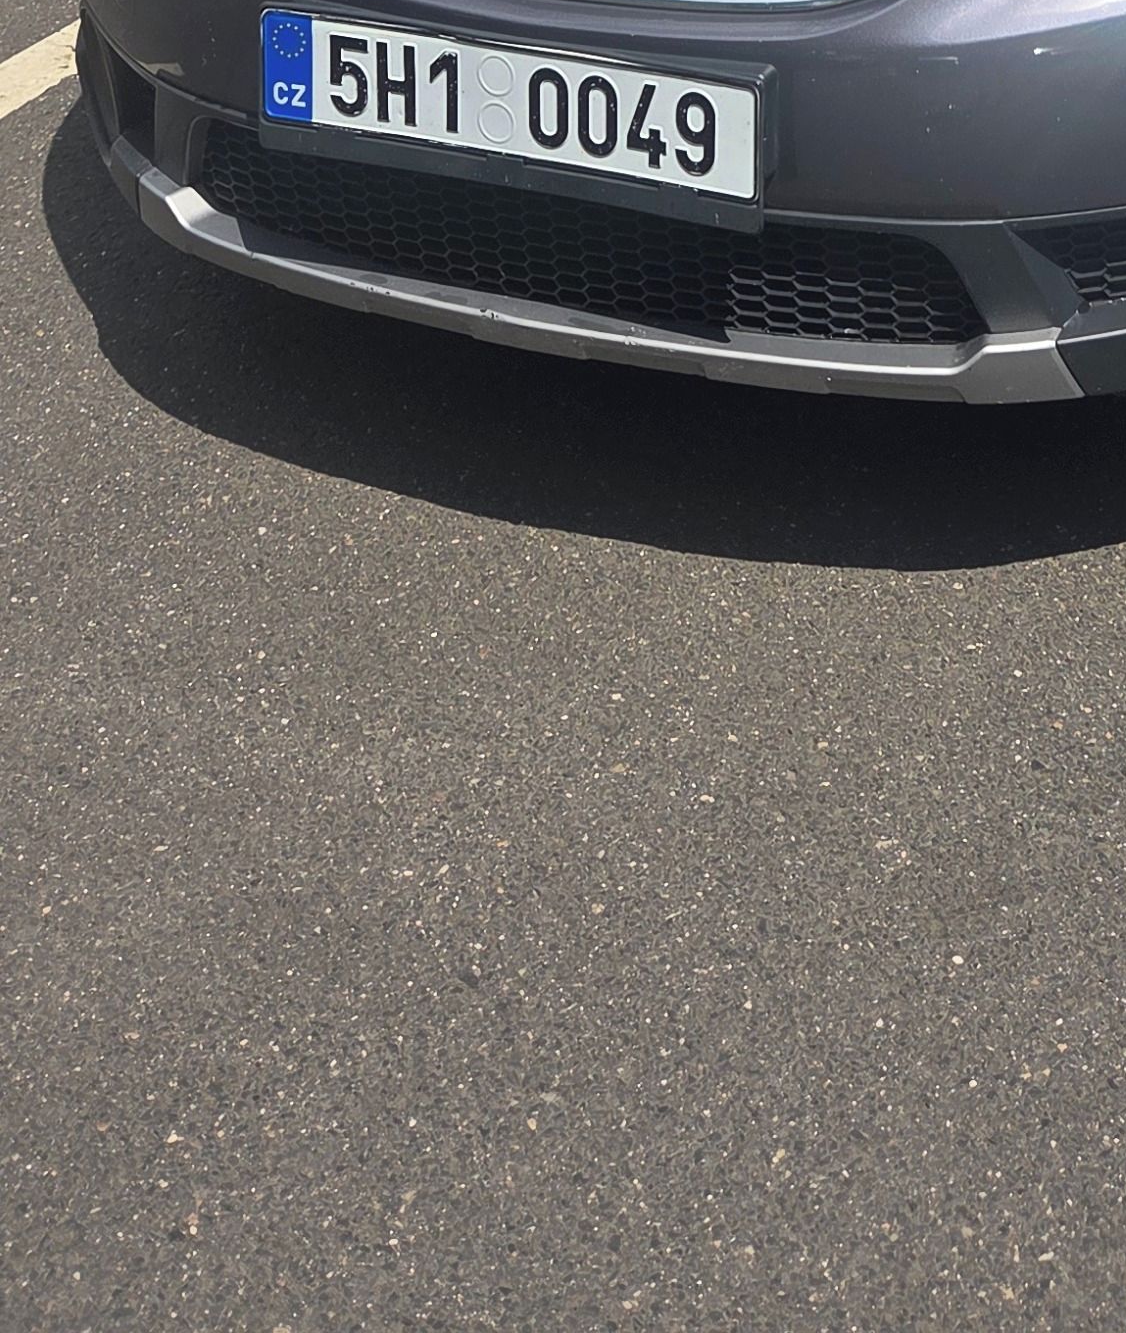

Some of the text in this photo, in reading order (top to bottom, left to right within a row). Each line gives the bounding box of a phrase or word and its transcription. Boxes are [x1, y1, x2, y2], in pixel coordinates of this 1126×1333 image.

[272, 81, 307, 108] CZ
[329, 34, 716, 177] 5H1 0049
